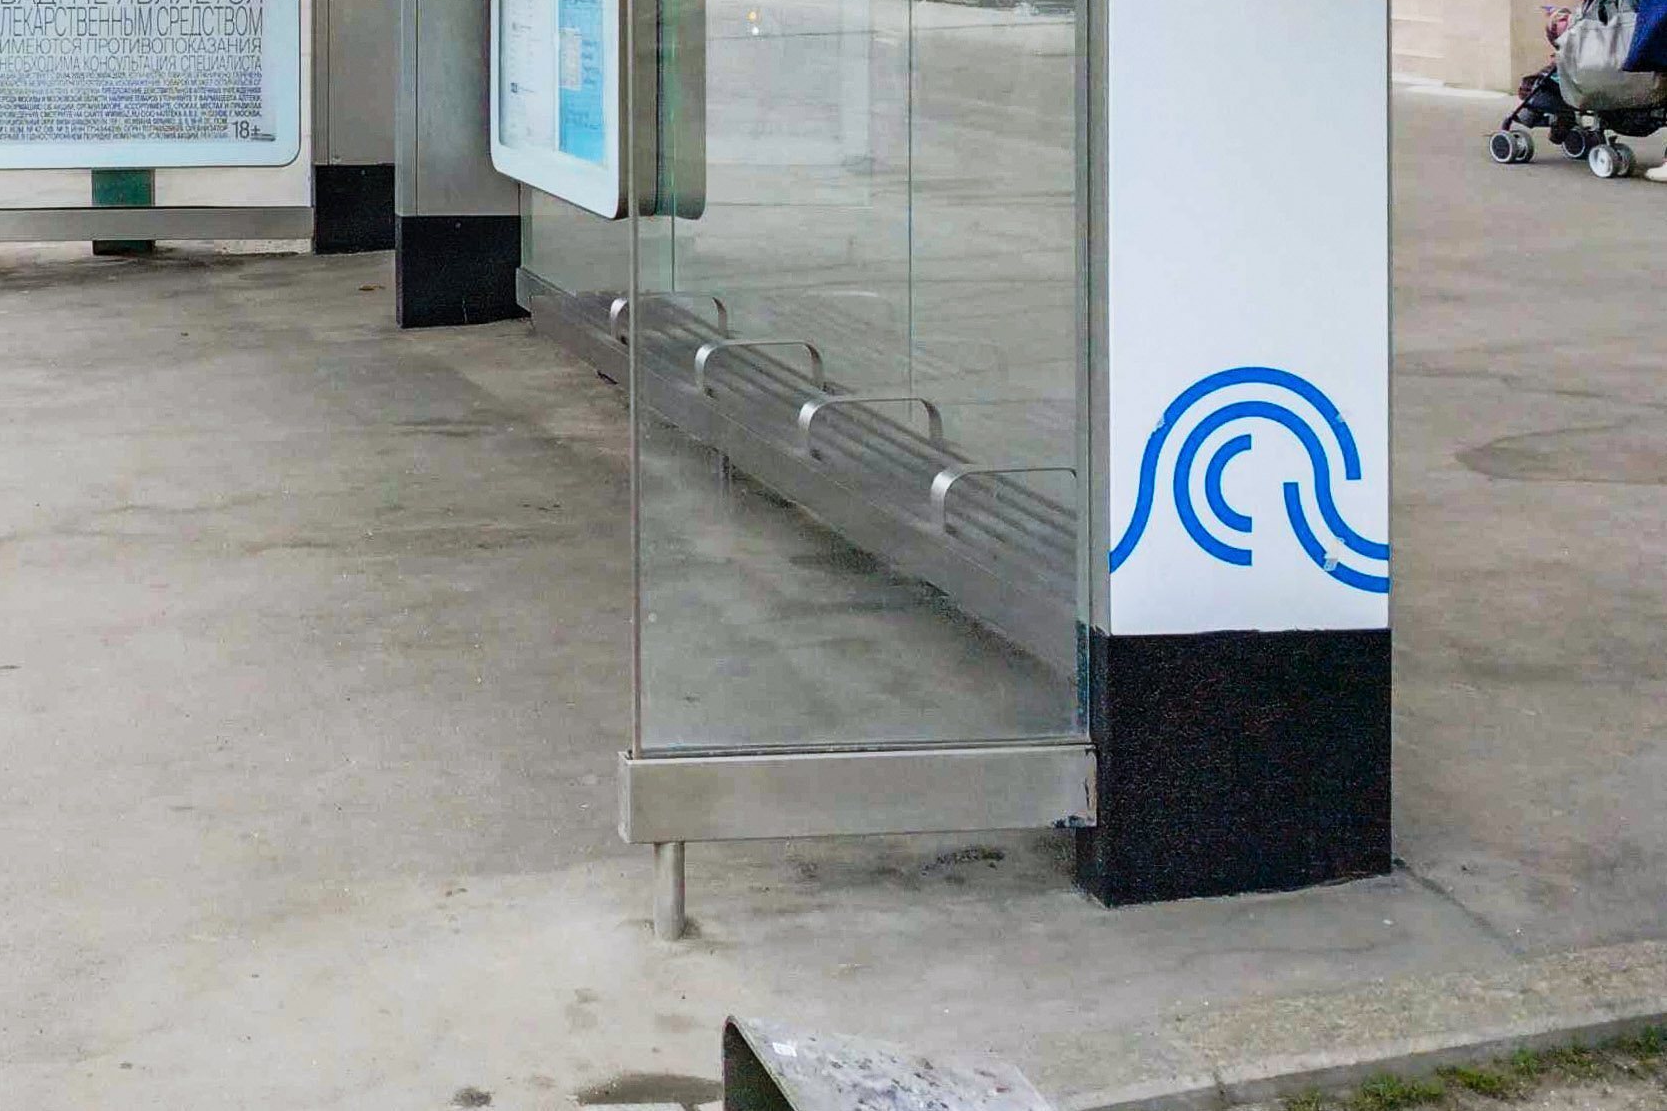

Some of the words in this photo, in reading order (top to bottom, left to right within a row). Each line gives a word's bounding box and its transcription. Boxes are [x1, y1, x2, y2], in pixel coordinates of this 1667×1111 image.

[0, 7, 152, 36] ЛЕКАРСТВЕННЫМ
[157, 6, 263, 36] СРЕДСТВОМ
[0, 38, 82, 54] ИМЕЮТСЯ
[87, 37, 262, 54] ПРОТИВОПОКАЗАНИЯ
[0, 56, 80, 71] НЕОБХОДИМА
[83, 56, 176, 72] КОНСУЛЬТАЦИЯ
[180, 55, 262, 71] СПЕЦИАЛИСТА
[232, 120, 261, 139] 18+
